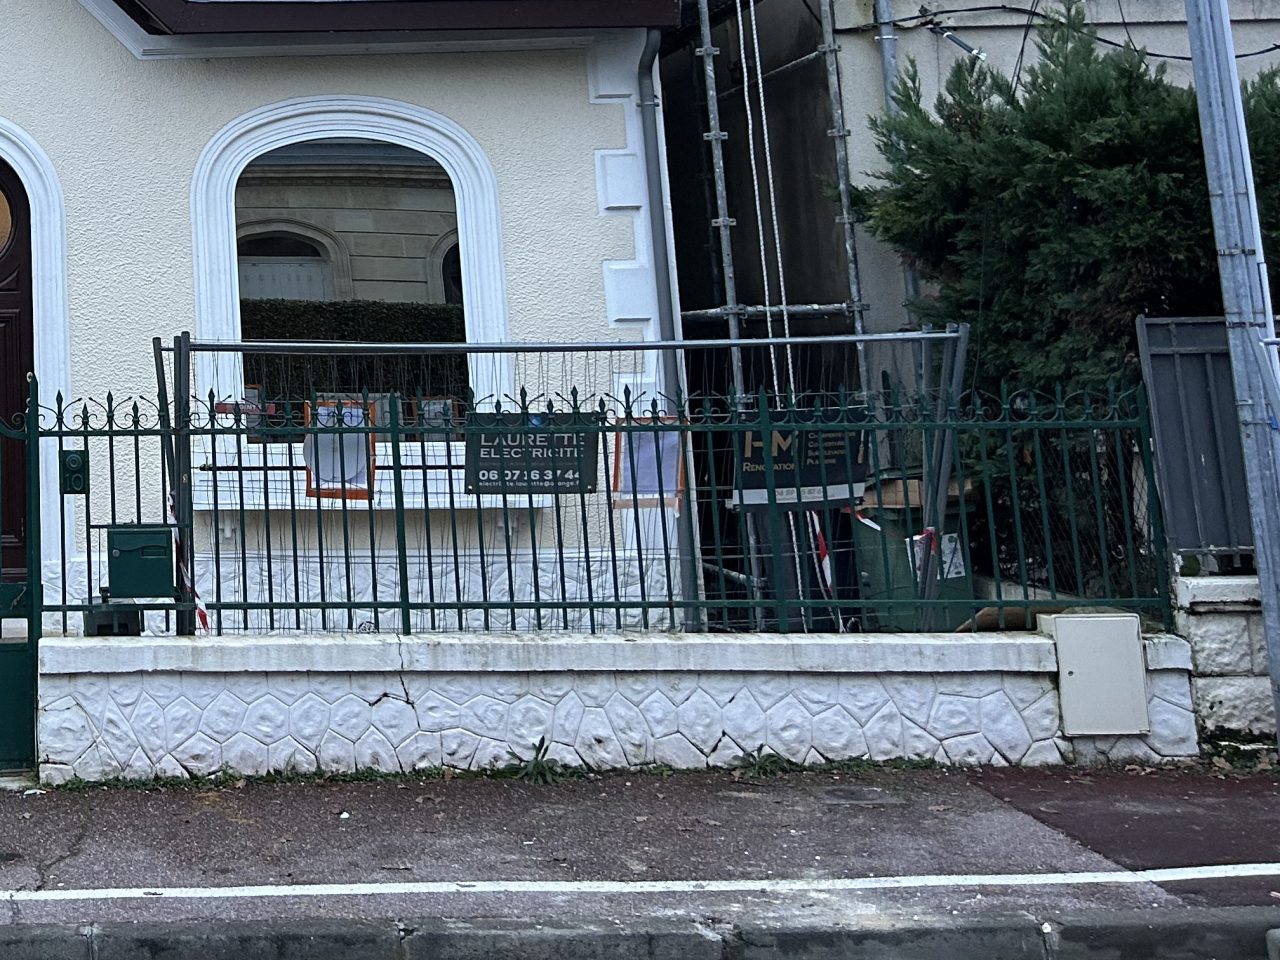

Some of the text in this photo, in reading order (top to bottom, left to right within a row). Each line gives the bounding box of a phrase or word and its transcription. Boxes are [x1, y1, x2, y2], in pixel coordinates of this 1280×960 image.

[479, 447, 584, 458] ELECRICITE
[478, 470, 499, 480] 06
[64, 473, 84, 491] 10
